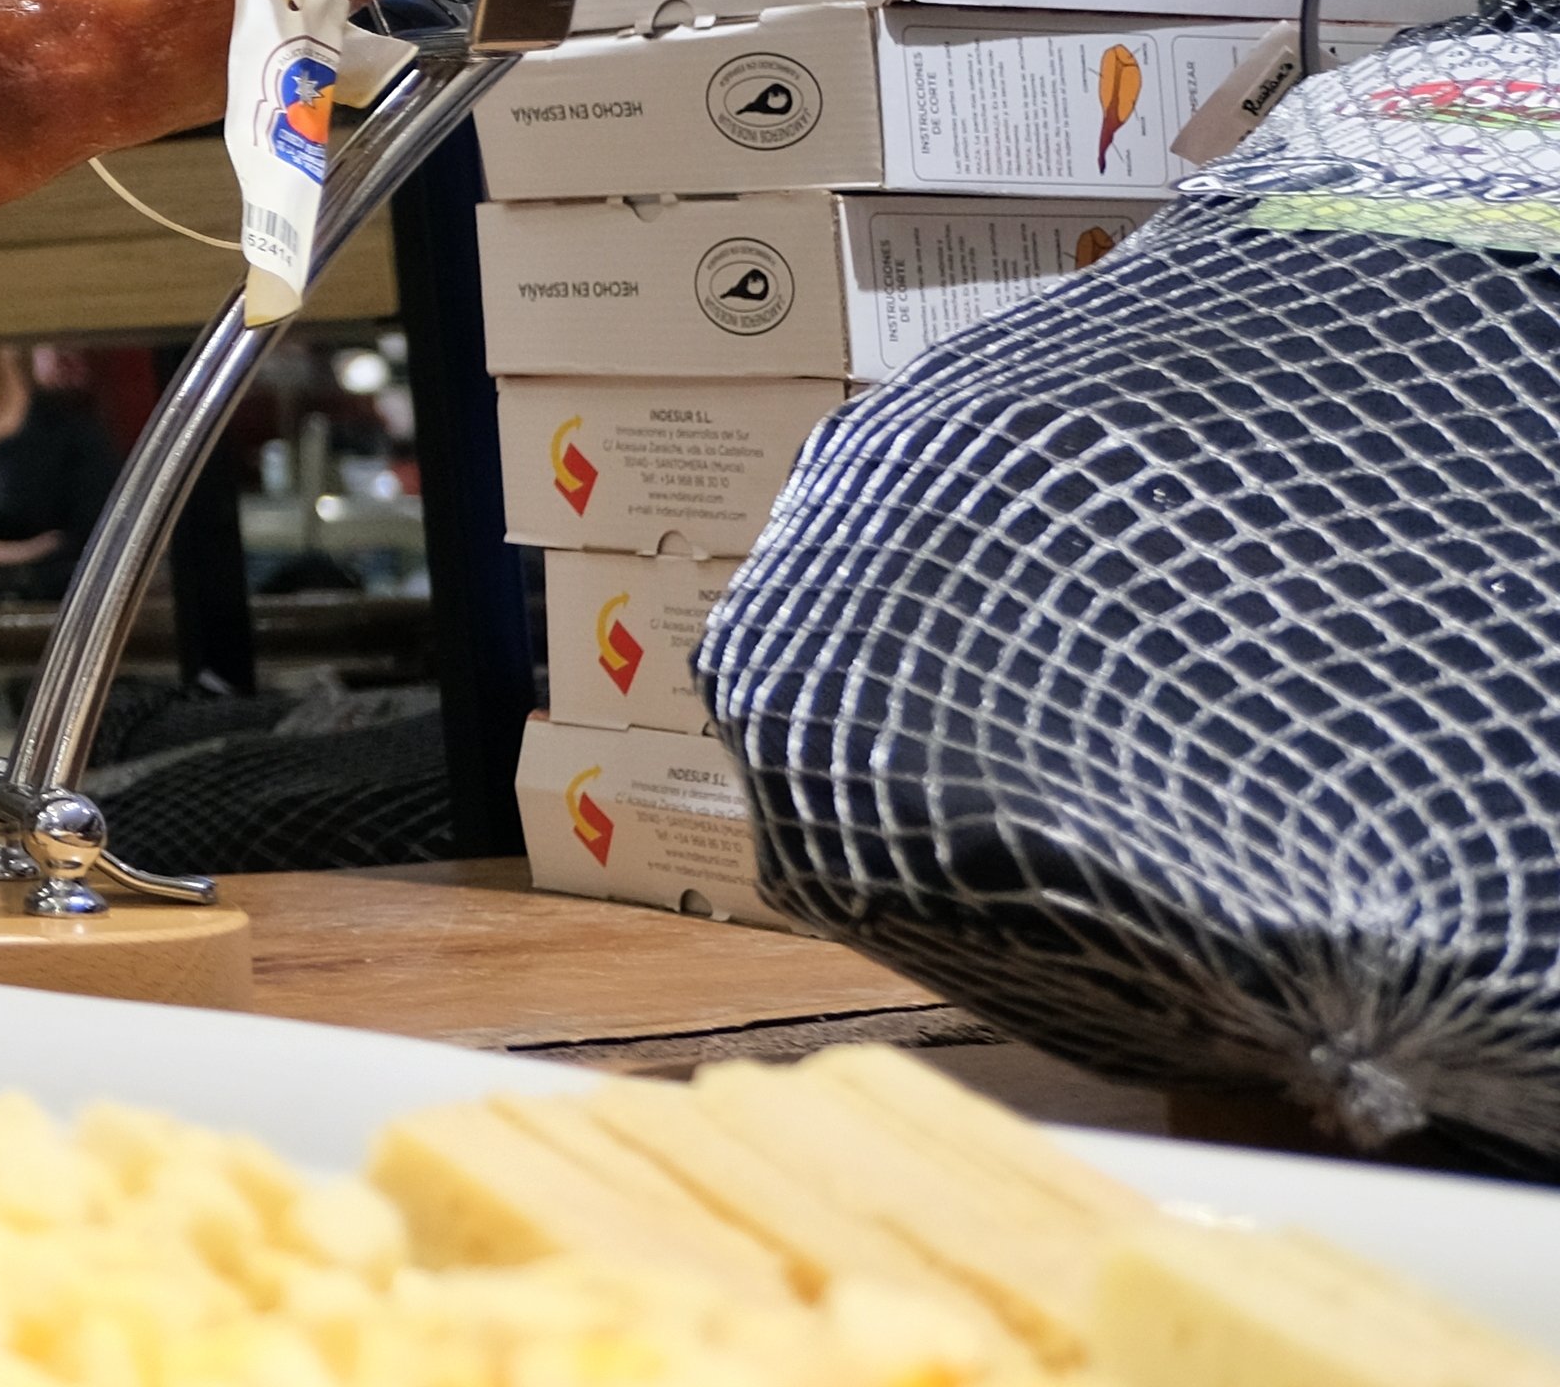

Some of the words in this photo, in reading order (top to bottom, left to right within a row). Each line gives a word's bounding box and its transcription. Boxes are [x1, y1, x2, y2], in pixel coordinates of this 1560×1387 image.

[927, 72, 939, 115] CORTE
[568, 103, 589, 120] EN
[591, 101, 644, 119] HECHO
[913, 51, 930, 155] INSTRUCCIONES
[510, 104, 567, 127] ESPAÑA
[931, 118, 942, 135] DE
[895, 259, 909, 302] CORTE
[518, 282, 569, 302] ESPAÑA
[571, 282, 589, 298] EN
[592, 281, 639, 298] HECHO
[880, 239, 899, 342] INSTRUCCIONES
[899, 306, 910, 323] DE
[650, 408, 694, 423] INDESUR
[667, 767, 710, 783] INDESUR
